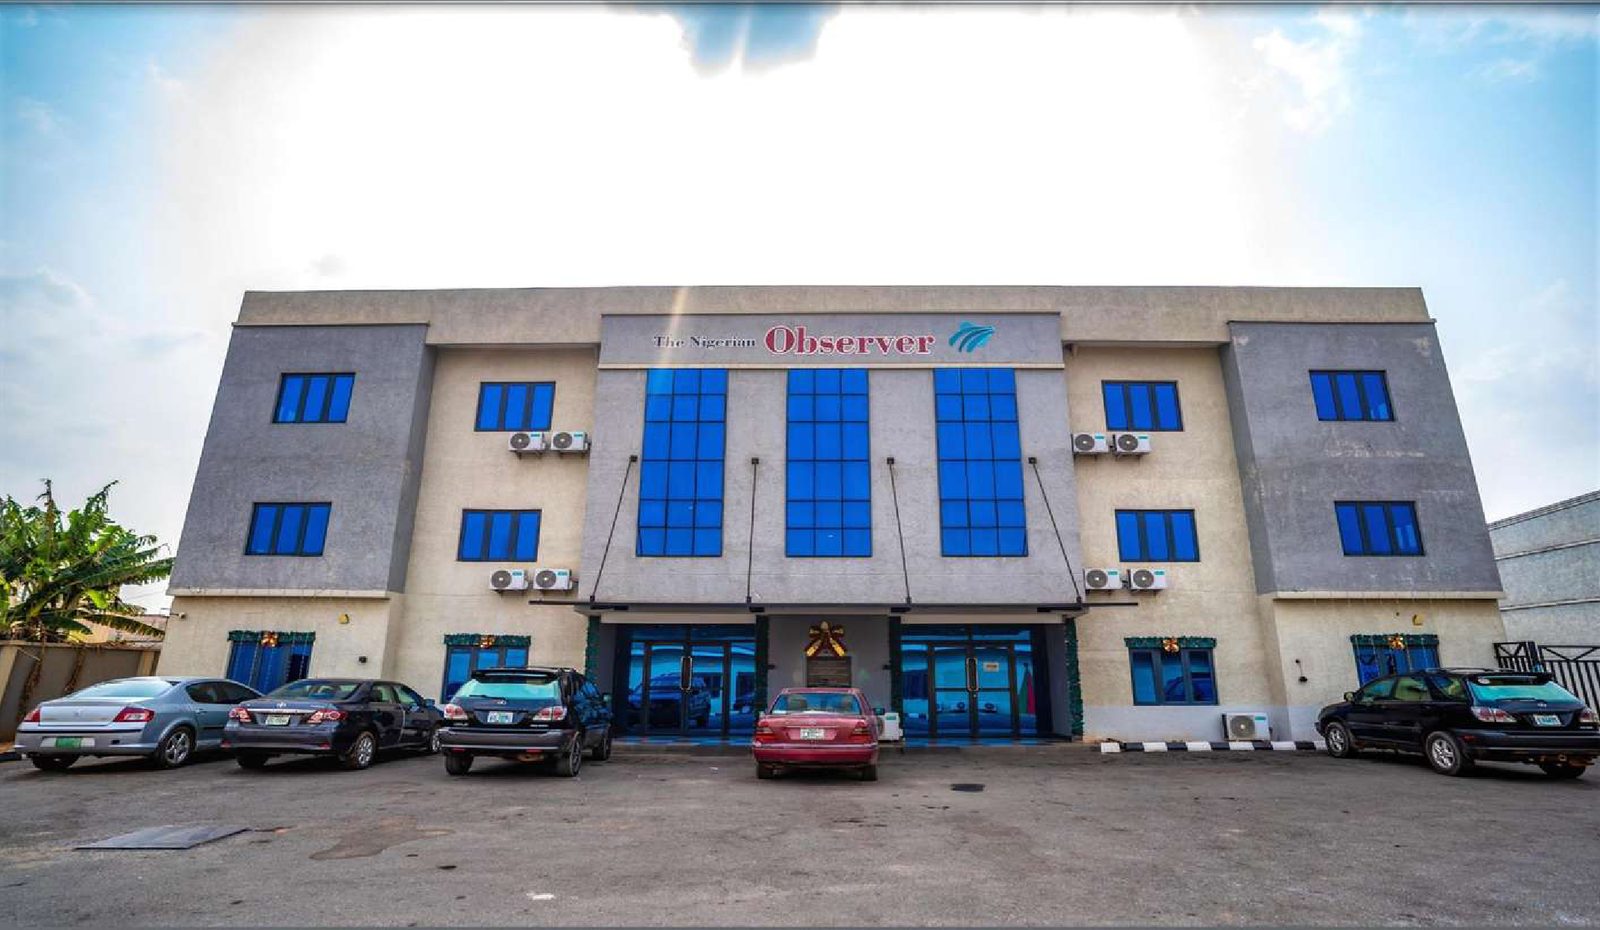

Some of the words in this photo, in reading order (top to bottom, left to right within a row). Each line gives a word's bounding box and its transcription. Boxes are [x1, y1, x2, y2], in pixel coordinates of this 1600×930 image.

[653, 335, 684, 347] The
[690, 335, 756, 348] Nigerian
[764, 325, 936, 355] Observer
